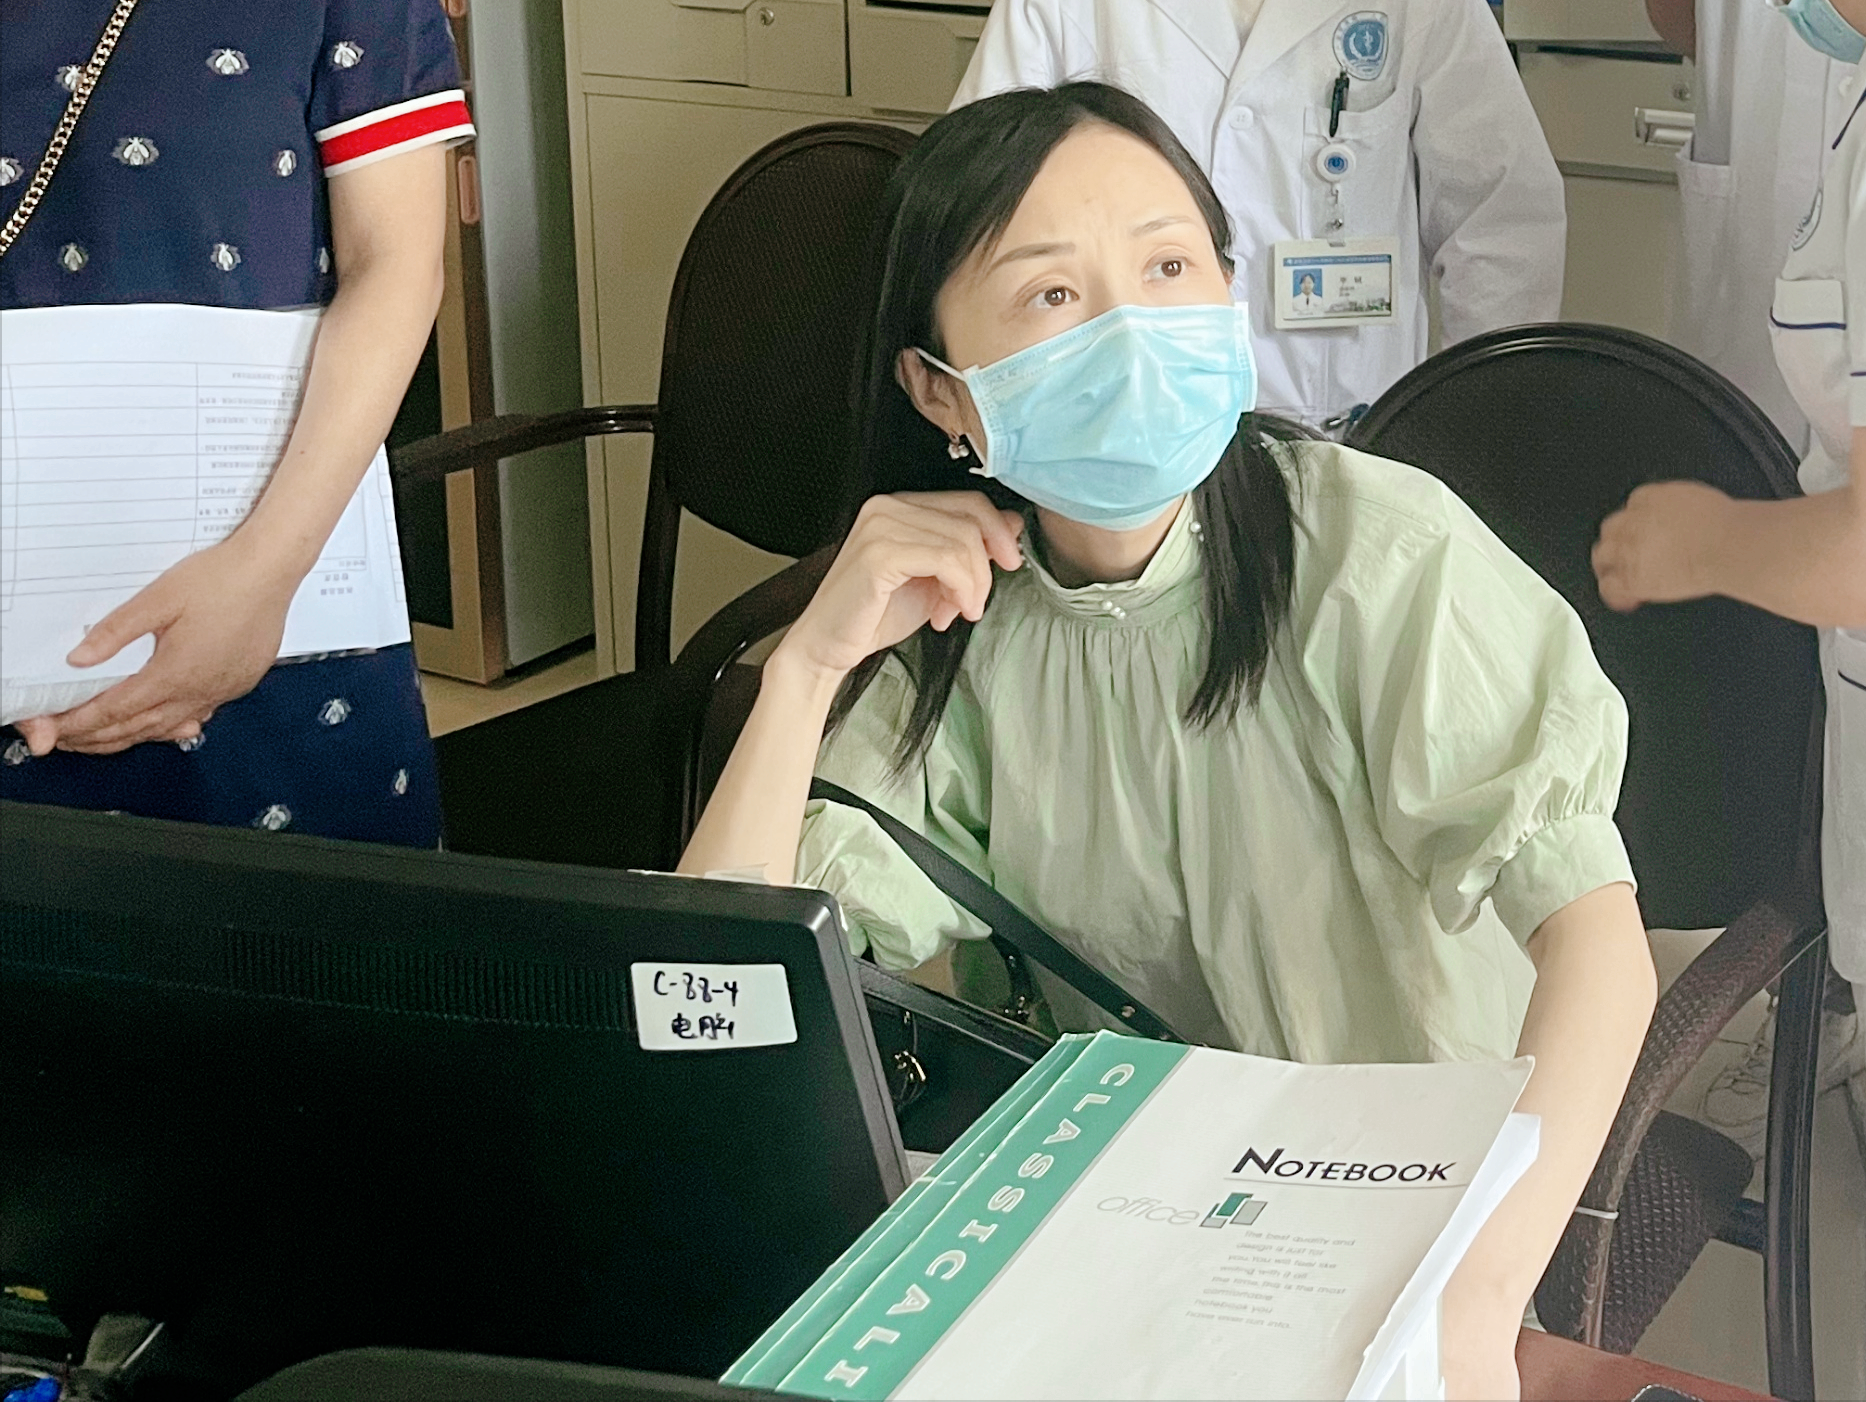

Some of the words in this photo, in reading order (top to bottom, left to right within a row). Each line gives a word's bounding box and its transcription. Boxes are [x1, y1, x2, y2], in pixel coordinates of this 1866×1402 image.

[1230, 1145, 1458, 1183] NOTEBOOK
[1095, 1195, 1201, 1226] office
[1332, 1239, 1356, 1247] and
